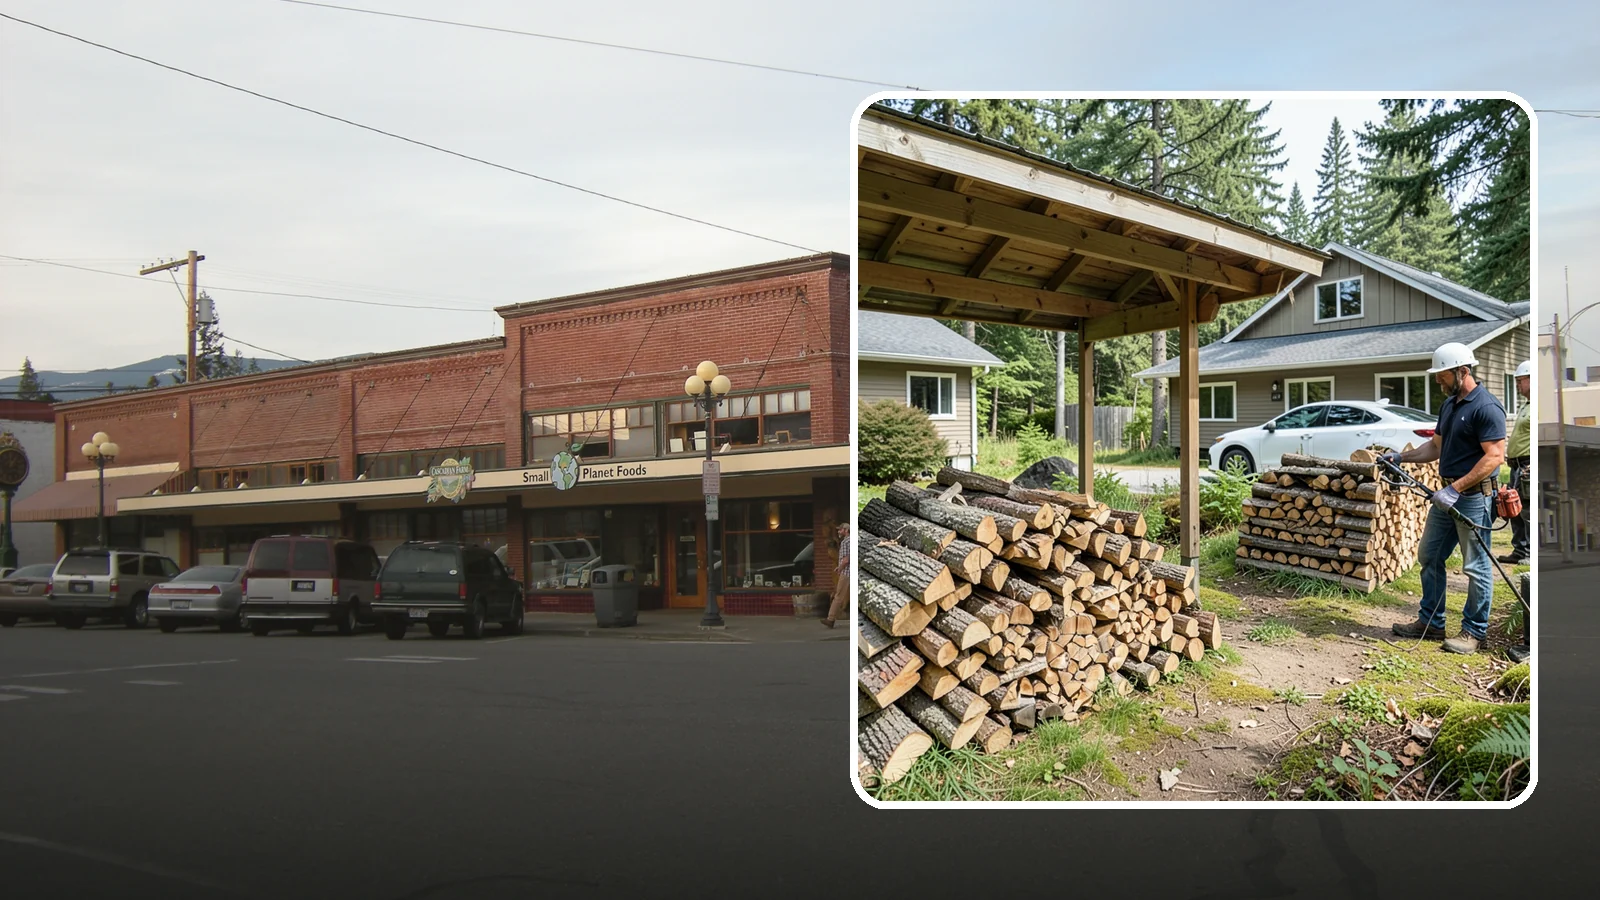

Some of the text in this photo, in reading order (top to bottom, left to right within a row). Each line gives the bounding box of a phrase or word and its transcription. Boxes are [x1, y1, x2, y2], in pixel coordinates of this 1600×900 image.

[523, 464, 647, 483] Small Planet Foods
